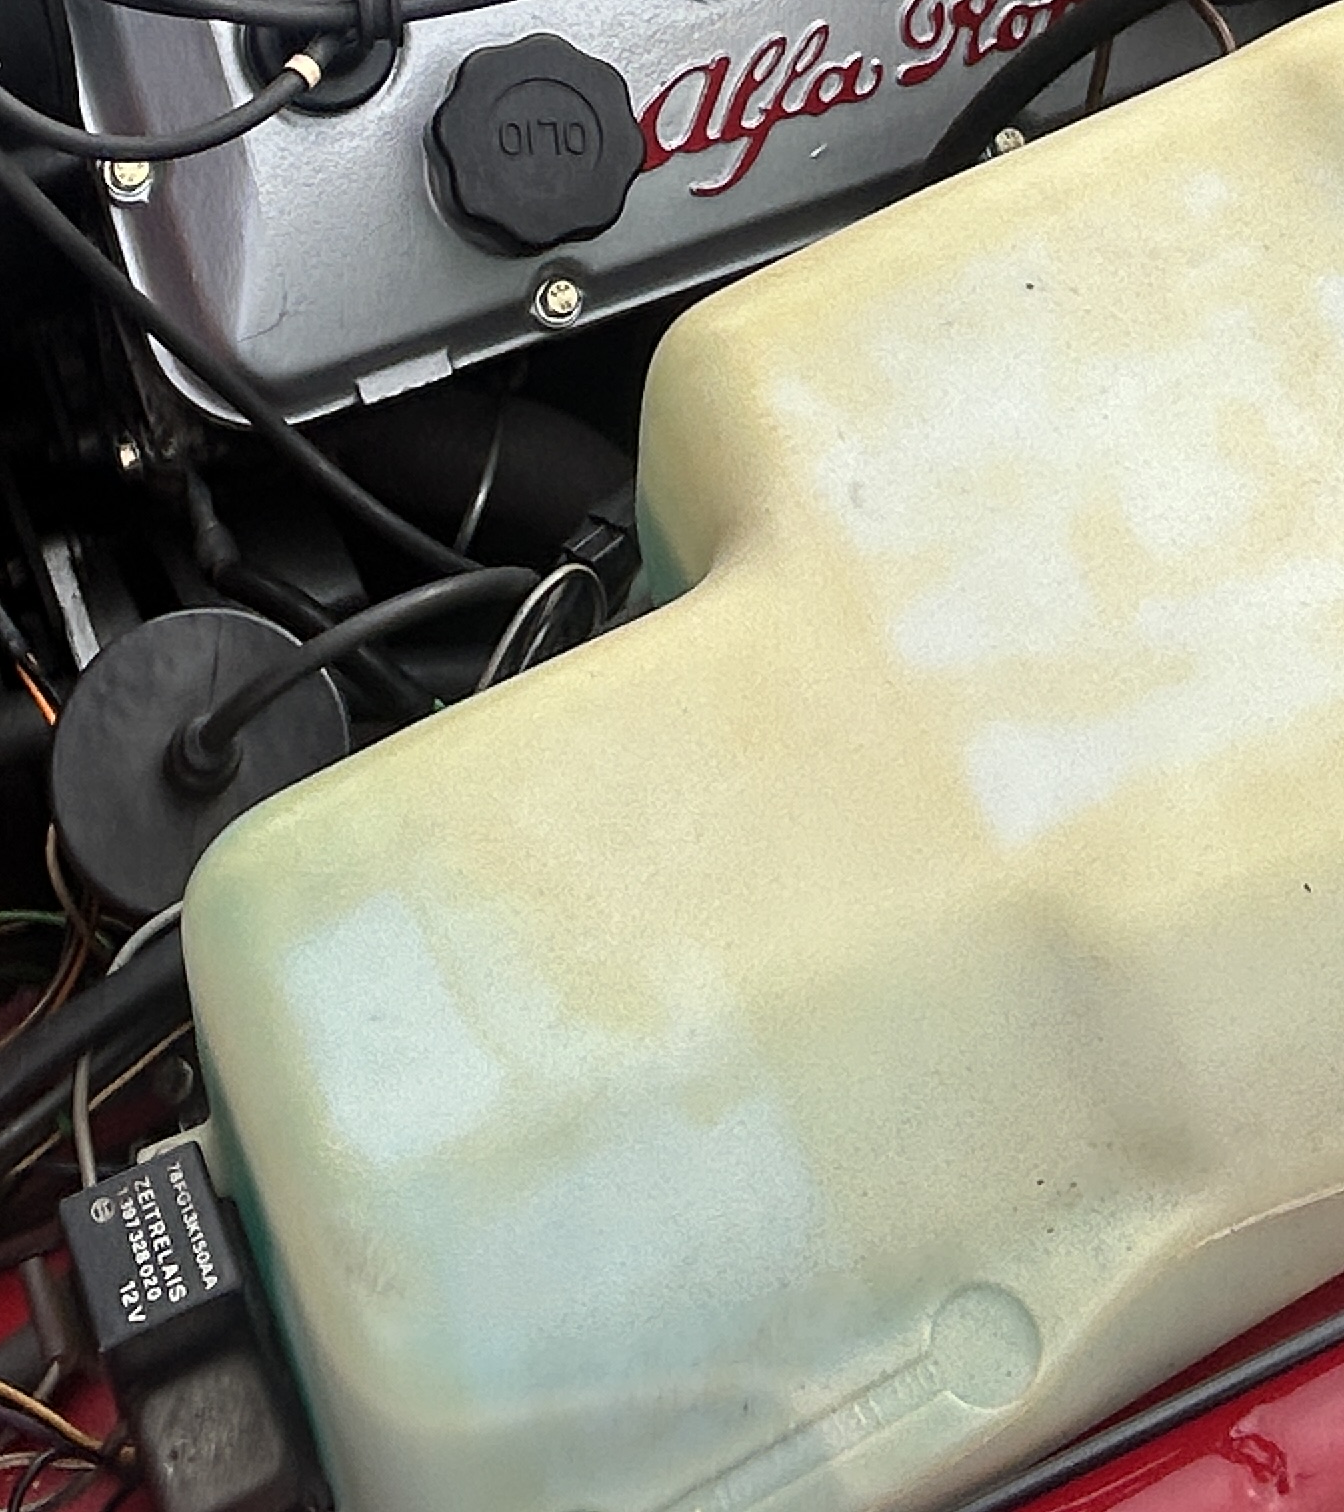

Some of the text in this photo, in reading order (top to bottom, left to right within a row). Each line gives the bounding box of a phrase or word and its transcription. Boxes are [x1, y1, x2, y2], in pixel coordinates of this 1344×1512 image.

[498, 118, 586, 157] OLIO
[639, 18, 884, 198] Alfa
[135, 1176, 188, 1303] ZEITRELAIS
